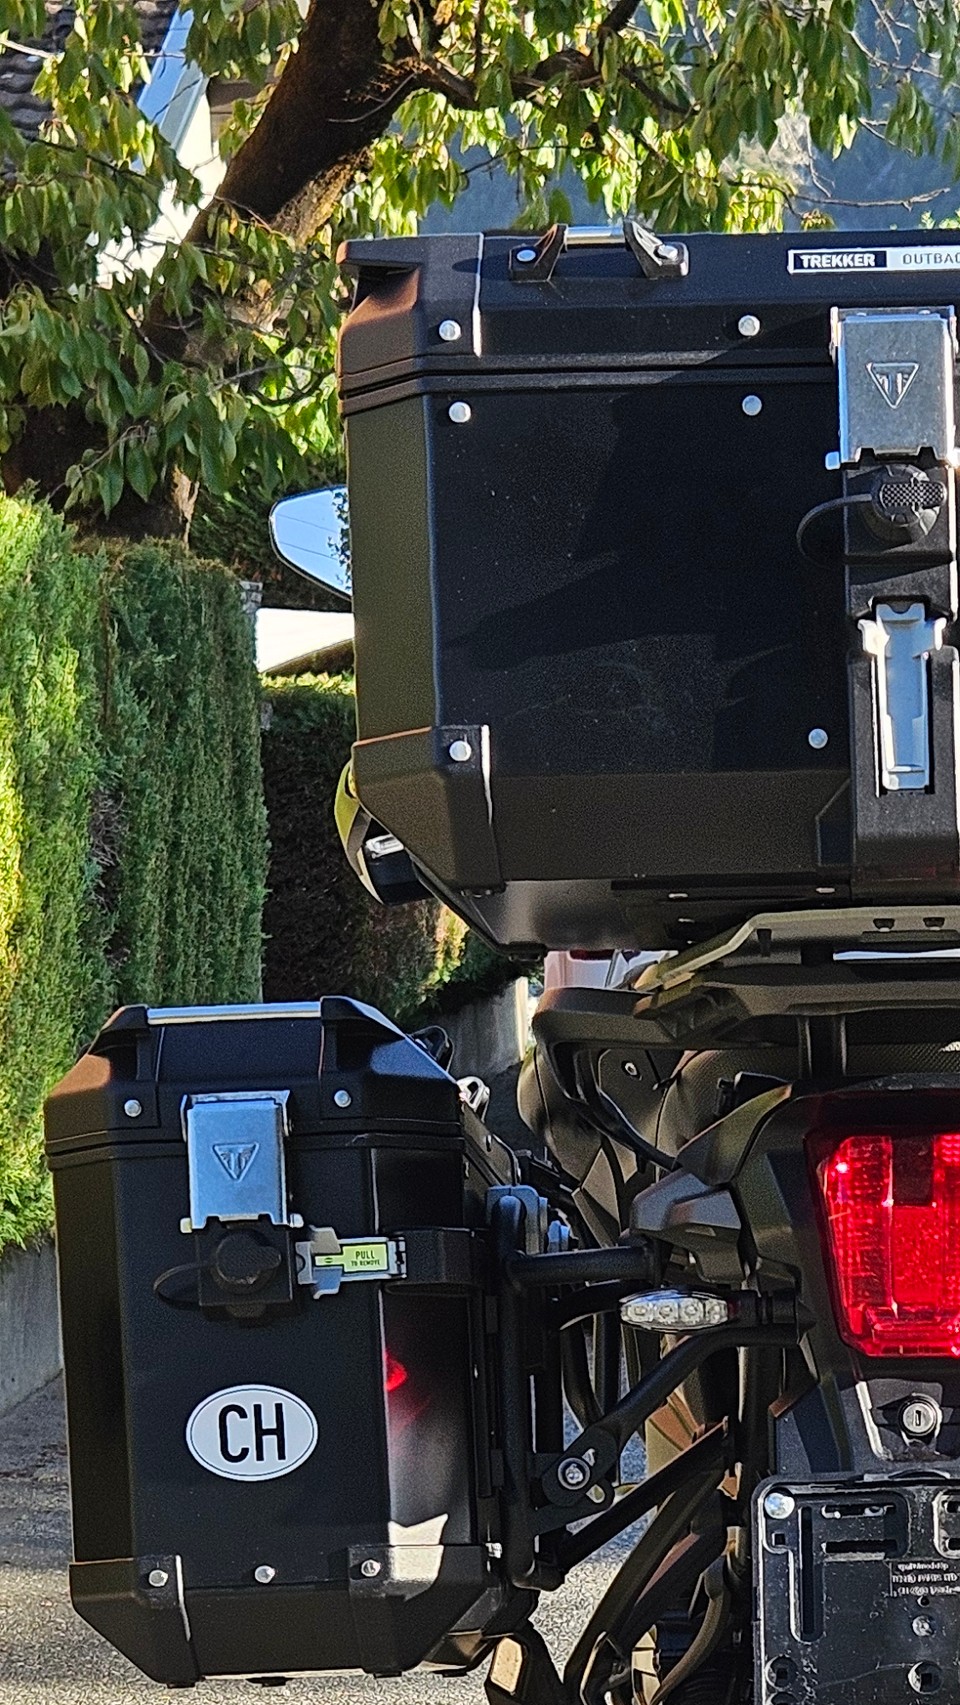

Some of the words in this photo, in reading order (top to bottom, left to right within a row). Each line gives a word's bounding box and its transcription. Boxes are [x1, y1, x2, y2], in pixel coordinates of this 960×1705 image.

[800, 253, 875, 268] TREKKER
[355, 1250, 375, 1260] PULL
[218, 1402, 287, 1463] CH
